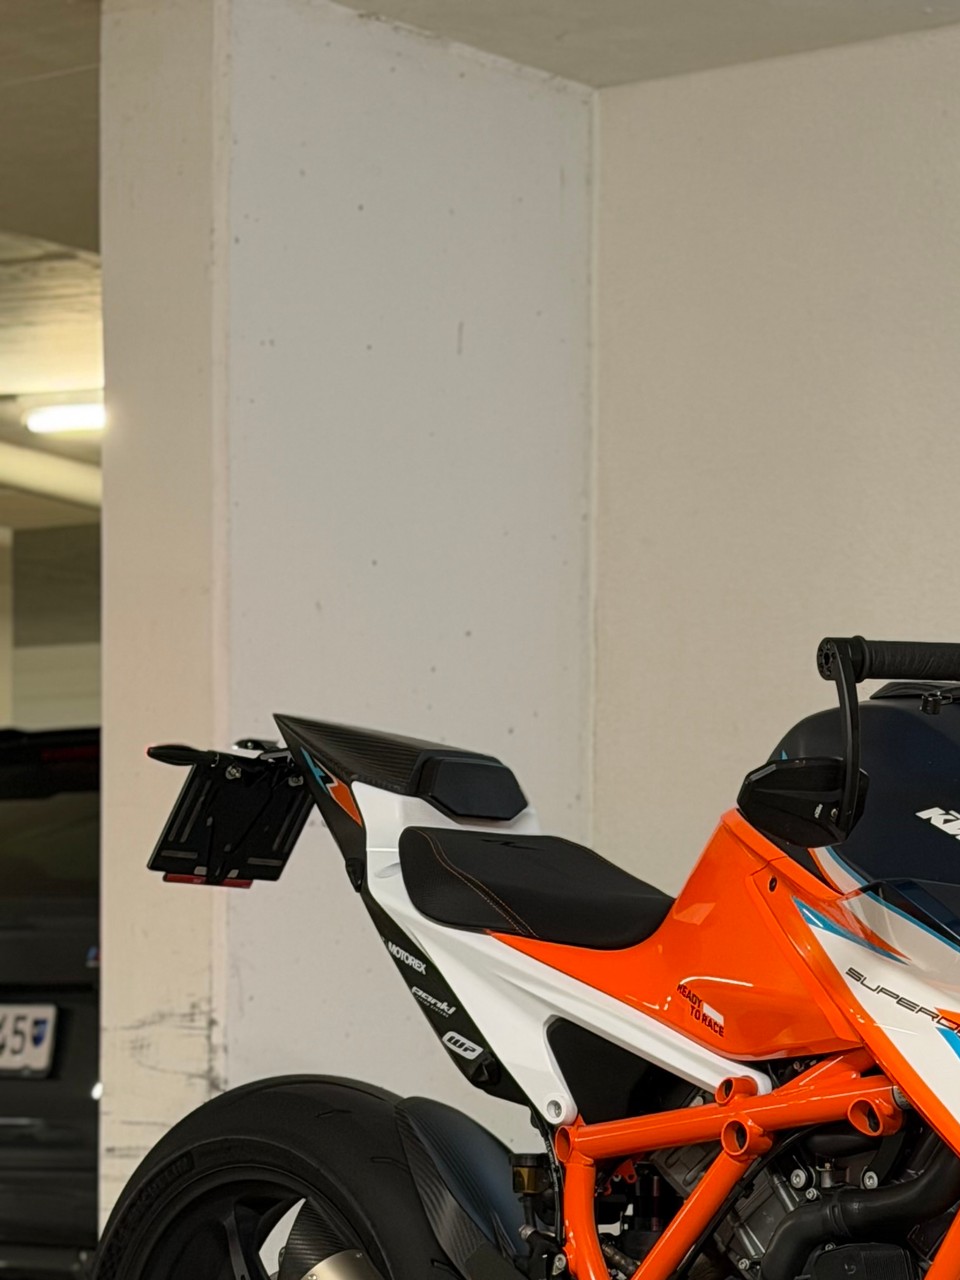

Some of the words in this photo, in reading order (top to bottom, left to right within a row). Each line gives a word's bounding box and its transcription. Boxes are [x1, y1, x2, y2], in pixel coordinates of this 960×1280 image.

[388, 941, 427, 975] MOTOREX
[411, 986, 456, 1015] pankl
[677, 984, 702, 1008] READY
[690, 1004, 701, 1021] TO
[702, 1013, 724, 1038] RACE
